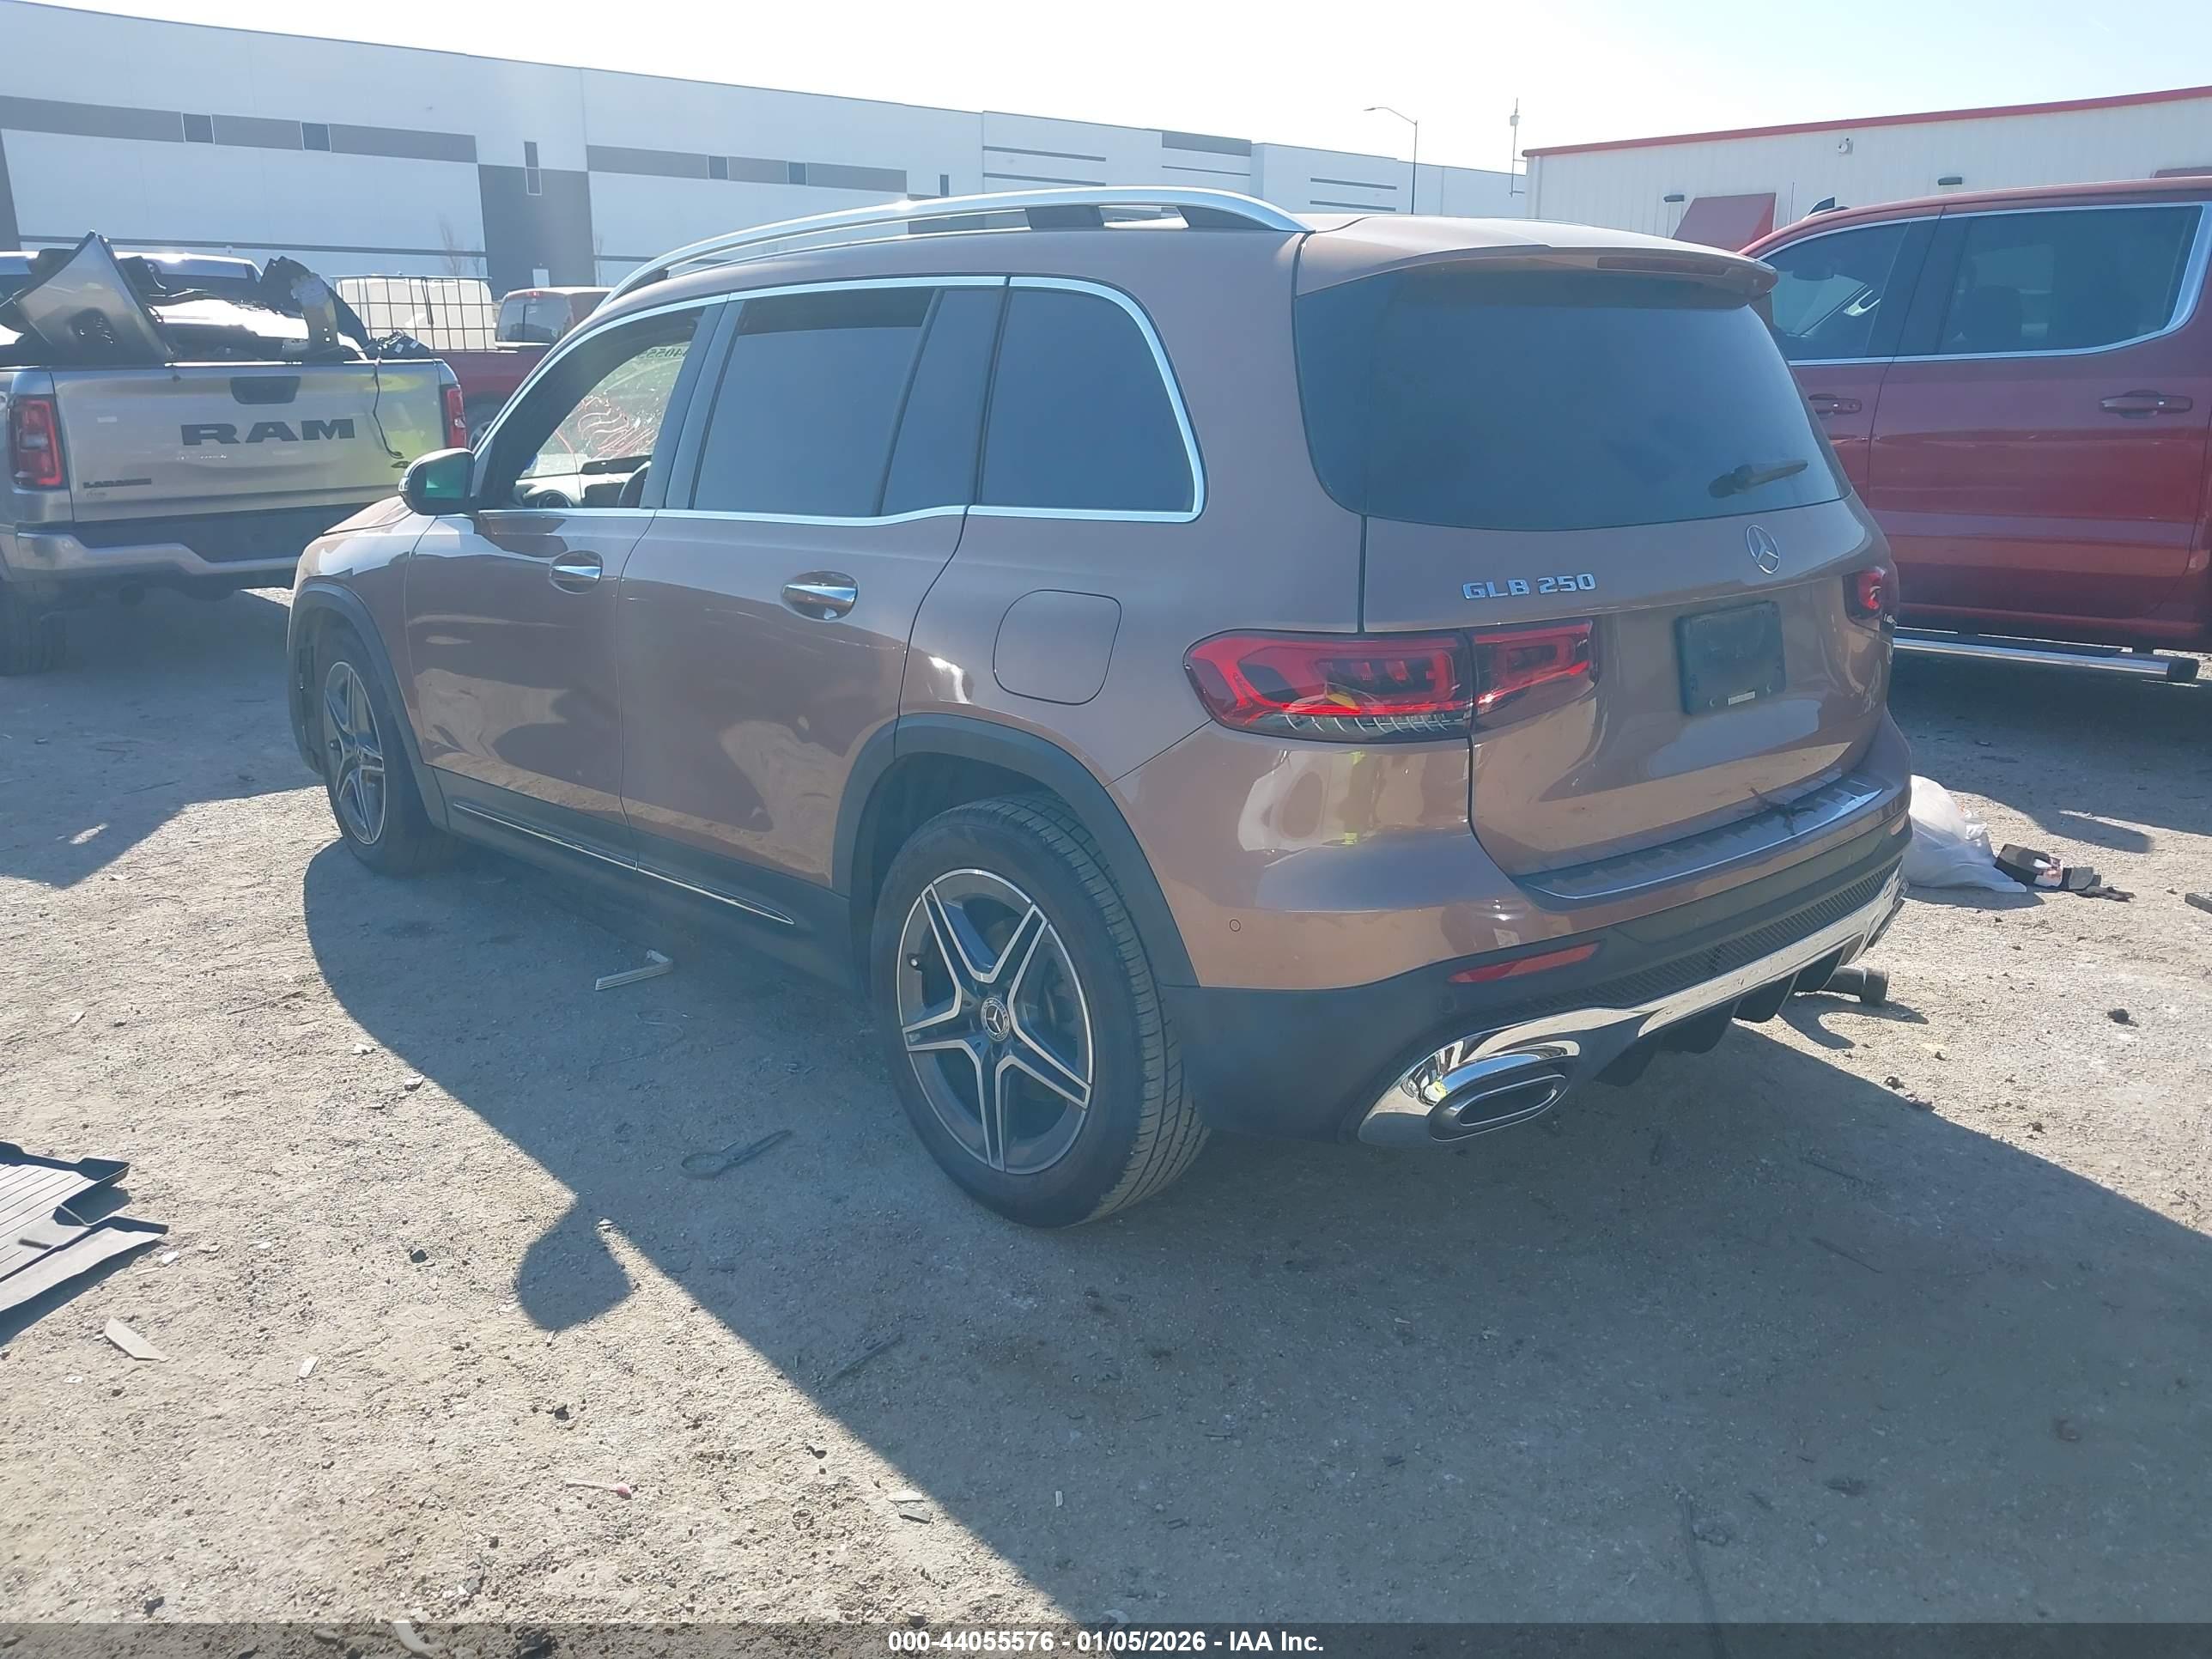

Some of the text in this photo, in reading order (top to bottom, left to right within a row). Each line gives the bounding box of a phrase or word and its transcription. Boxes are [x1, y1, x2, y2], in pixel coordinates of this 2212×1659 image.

[180, 418, 356, 446] RAM
[1462, 573, 1596, 599] GLB 250
